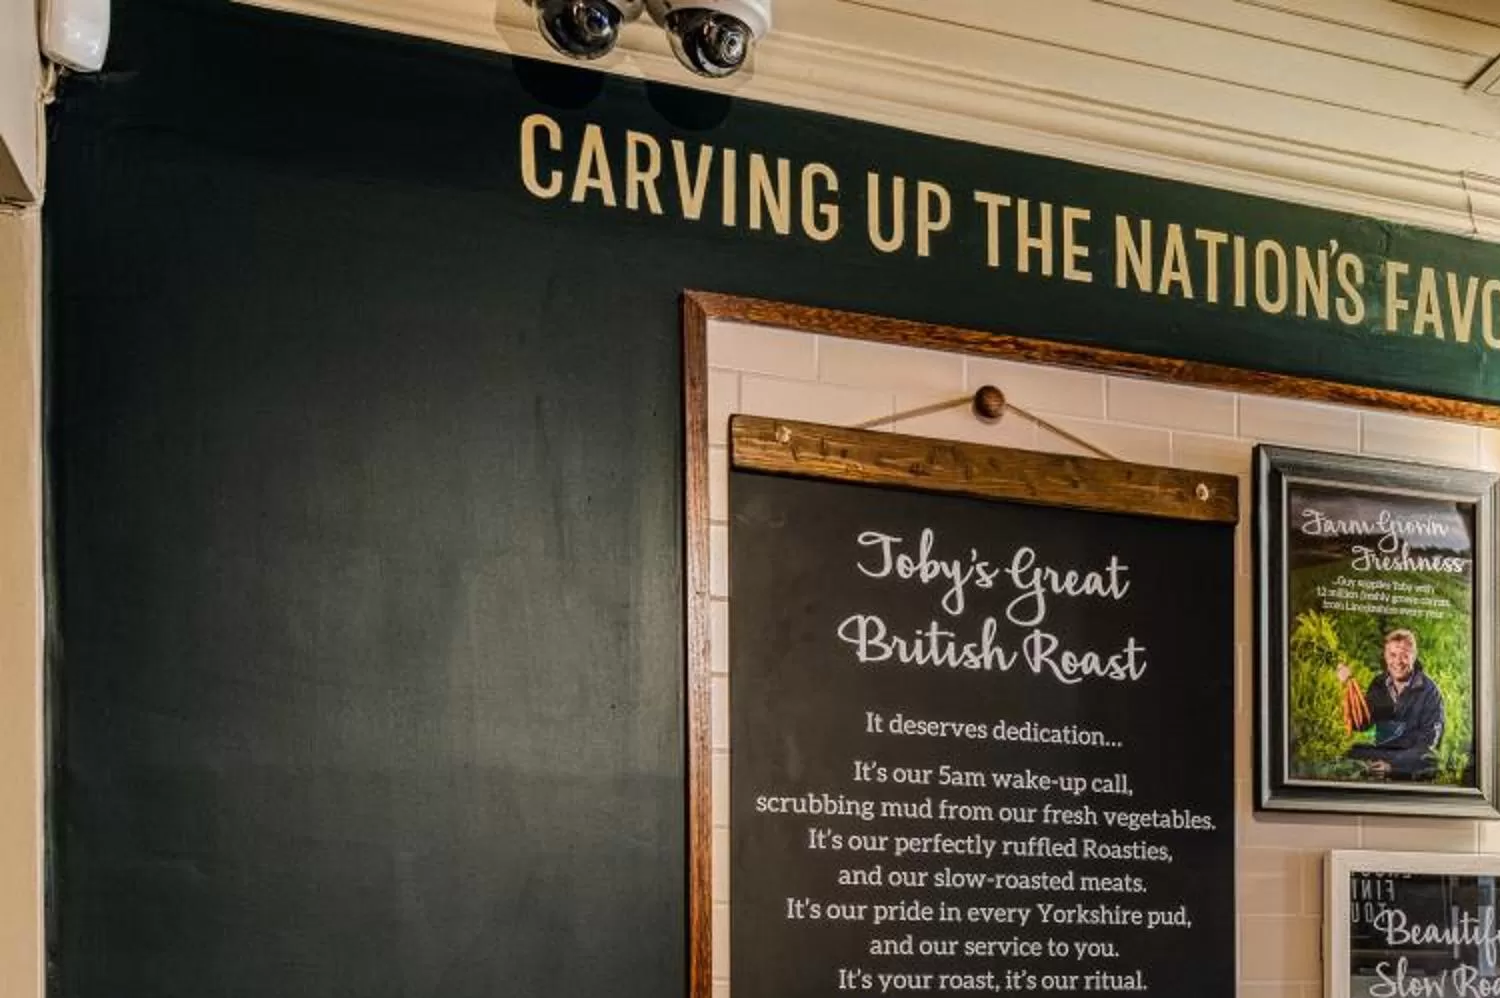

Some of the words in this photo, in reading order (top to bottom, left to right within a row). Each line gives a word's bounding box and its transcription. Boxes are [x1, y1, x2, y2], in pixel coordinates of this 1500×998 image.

[520, 113, 840, 242] CARVING
[867, 172, 951, 257] UP
[974, 192, 1092, 283] THE
[1115, 215, 1364, 326] NATION'S
[1301, 509, 1374, 537] Farm
[1374, 510, 1449, 552] Grown
[1352, 543, 1472, 573] Freshness
[857, 528, 998, 615] Toby's
[1006, 547, 1131, 627] Great
[838, 615, 1017, 671] British
[1024, 629, 1147, 683] Roast
[866, 712, 883, 732] It
[889, 714, 987, 738] deserves
[854, 761, 887, 782] It's
[893, 768, 933, 784] our
[939, 765, 986, 787] 5am
[992, 769, 1086, 795] wake-up
[756, 793, 874, 820] scrubbing
[881, 798, 933, 818] mud
[939, 800, 993, 820] from
[999, 808, 1037, 822] our
[1043, 804, 1097, 825] fresh
[809, 828, 842, 849] It's
[848, 836, 888, 851] our
[895, 834, 996, 858] perfectly
[1002, 837, 1077, 857] ruffled
[838, 865, 882, 885] and
[888, 872, 928, 886] our
[934, 867, 1074, 890] slow-roasted
[787, 898, 821, 919] It's
[826, 904, 867, 920] our
[874, 900, 933, 924] pride
[940, 902, 962, 921] in
[968, 908, 1031, 926] every
[1037, 904, 1142, 924] Yorkshire
[870, 935, 913, 954] and
[920, 941, 958, 955] our
[965, 937, 1042, 956] service
[1048, 938, 1069, 956] to
[839, 968, 872, 989] It's
[878, 974, 933, 992] your
[1006, 970, 1036, 990] it's
[1042, 976, 1078, 990] our
[1370, 956, 1448, 998] Slow
